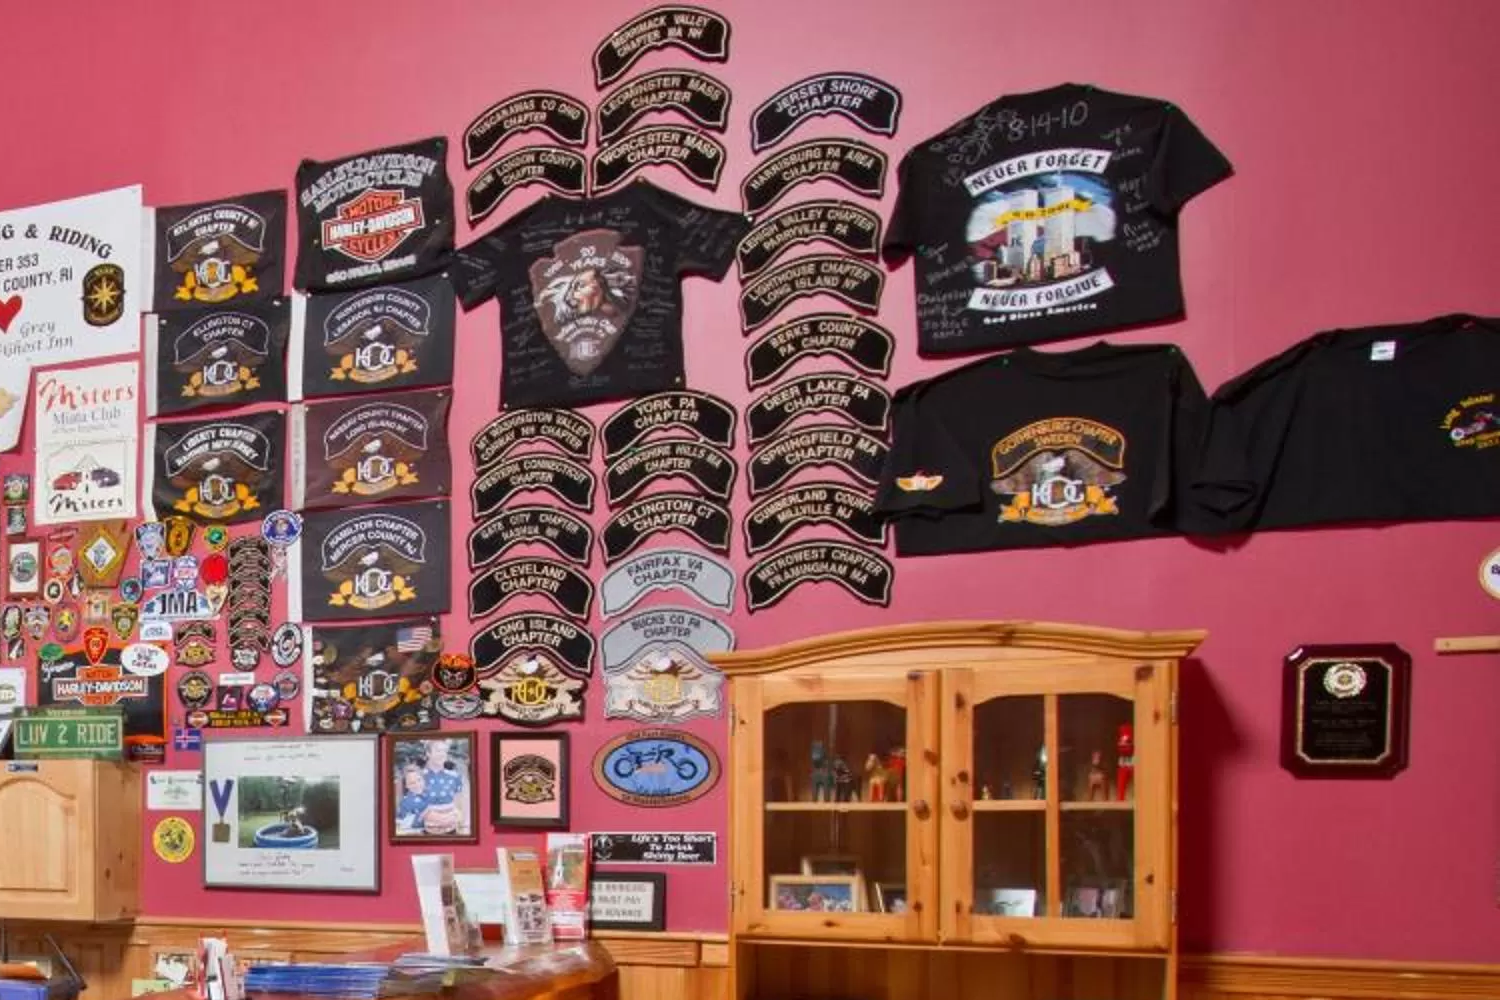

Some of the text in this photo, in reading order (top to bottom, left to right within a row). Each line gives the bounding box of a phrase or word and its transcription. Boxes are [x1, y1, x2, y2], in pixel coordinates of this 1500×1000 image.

[673, 14, 711, 28] VALLEY
[617, 31, 661, 57] CHAPTER
[603, 76, 722, 115] LEOMINSTER MASS
[631, 90, 691, 108] CHAPTER
[775, 80, 879, 113] JERSEY SHORE
[787, 94, 863, 117] CHAPTER
[503, 112, 547, 129] CHAPTER
[600, 131, 717, 166] WORCESTER MASS
[627, 145, 689, 163] CHAPTER
[495, 151, 577, 177] LONDON COUNTY
[750, 148, 822, 189] HARRISBURG
[782, 161, 841, 181] CHAPTER
[1035, 154, 1106, 169] FORGET
[502, 165, 545, 185] CHAPTER
[174, 213, 212, 236] ATLANTIC
[195, 222, 236, 237] CHAPTER
[741, 208, 876, 255] LEHIGH VALLEY CHAPTER
[25, 223, 39, 239] &
[49, 225, 113, 259] RIDING
[3, 271, 57, 293] COUNTY,
[59, 266, 73, 282] RI
[749, 263, 871, 301] LIGHTHOUSE CHAPTER
[1036, 274, 1102, 300] FORGIVE
[760, 275, 840, 306] LONG ISLAND
[387, 293, 420, 312] COUNTY
[194, 316, 240, 336] ELLINGTON
[385, 305, 422, 327] CHAPTER
[204, 329, 244, 342] CHAPTER
[769, 322, 867, 349] BERKS COUNTY
[801, 335, 857, 350] CHAPTER
[762, 379, 870, 411] DEER LAKE PA
[784, 393, 851, 413] CHAPTER
[635, 397, 697, 415] YORK PA
[488, 412, 591, 438] WASHINGTON VALLEY
[634, 410, 700, 430] CHAPTER
[540, 424, 583, 450] CHAPTER
[674, 444, 705, 458] HILLS
[760, 431, 878, 465] SPRINGFIELD MA
[784, 445, 855, 465] CHAPTER
[523, 459, 588, 484] CONNECTICUT
[644, 457, 692, 472] CHAPTER
[509, 471, 554, 486] CHAPTER
[618, 499, 716, 528] ELLINGTON CT
[753, 489, 828, 525] CUMBERLAND
[777, 503, 833, 524] MILLVILLE
[329, 520, 419, 548] HAMILTON CHAPTER
[539, 514, 580, 535] CHAPTER
[633, 515, 697, 533] CHAPTER
[494, 563, 567, 582] CLEVELAND
[627, 556, 703, 577] FAIRFAX VA
[756, 549, 883, 582] METROWEST CHAPTER
[767, 563, 870, 589] FRAMINGHAM MA
[500, 575, 561, 594] CHAPTER
[633, 569, 697, 586] CHAPTER
[160, 592, 198, 614] JMA
[491, 619, 577, 640] LONG ISLAND
[631, 615, 667, 632] BUCKS
[643, 627, 692, 639] CHAPTER
[502, 632, 561, 648] CHAPTER
[57, 680, 143, 695] HARLEY-DAVIDSON
[19, 723, 117, 745] LUV 2 RIDE
